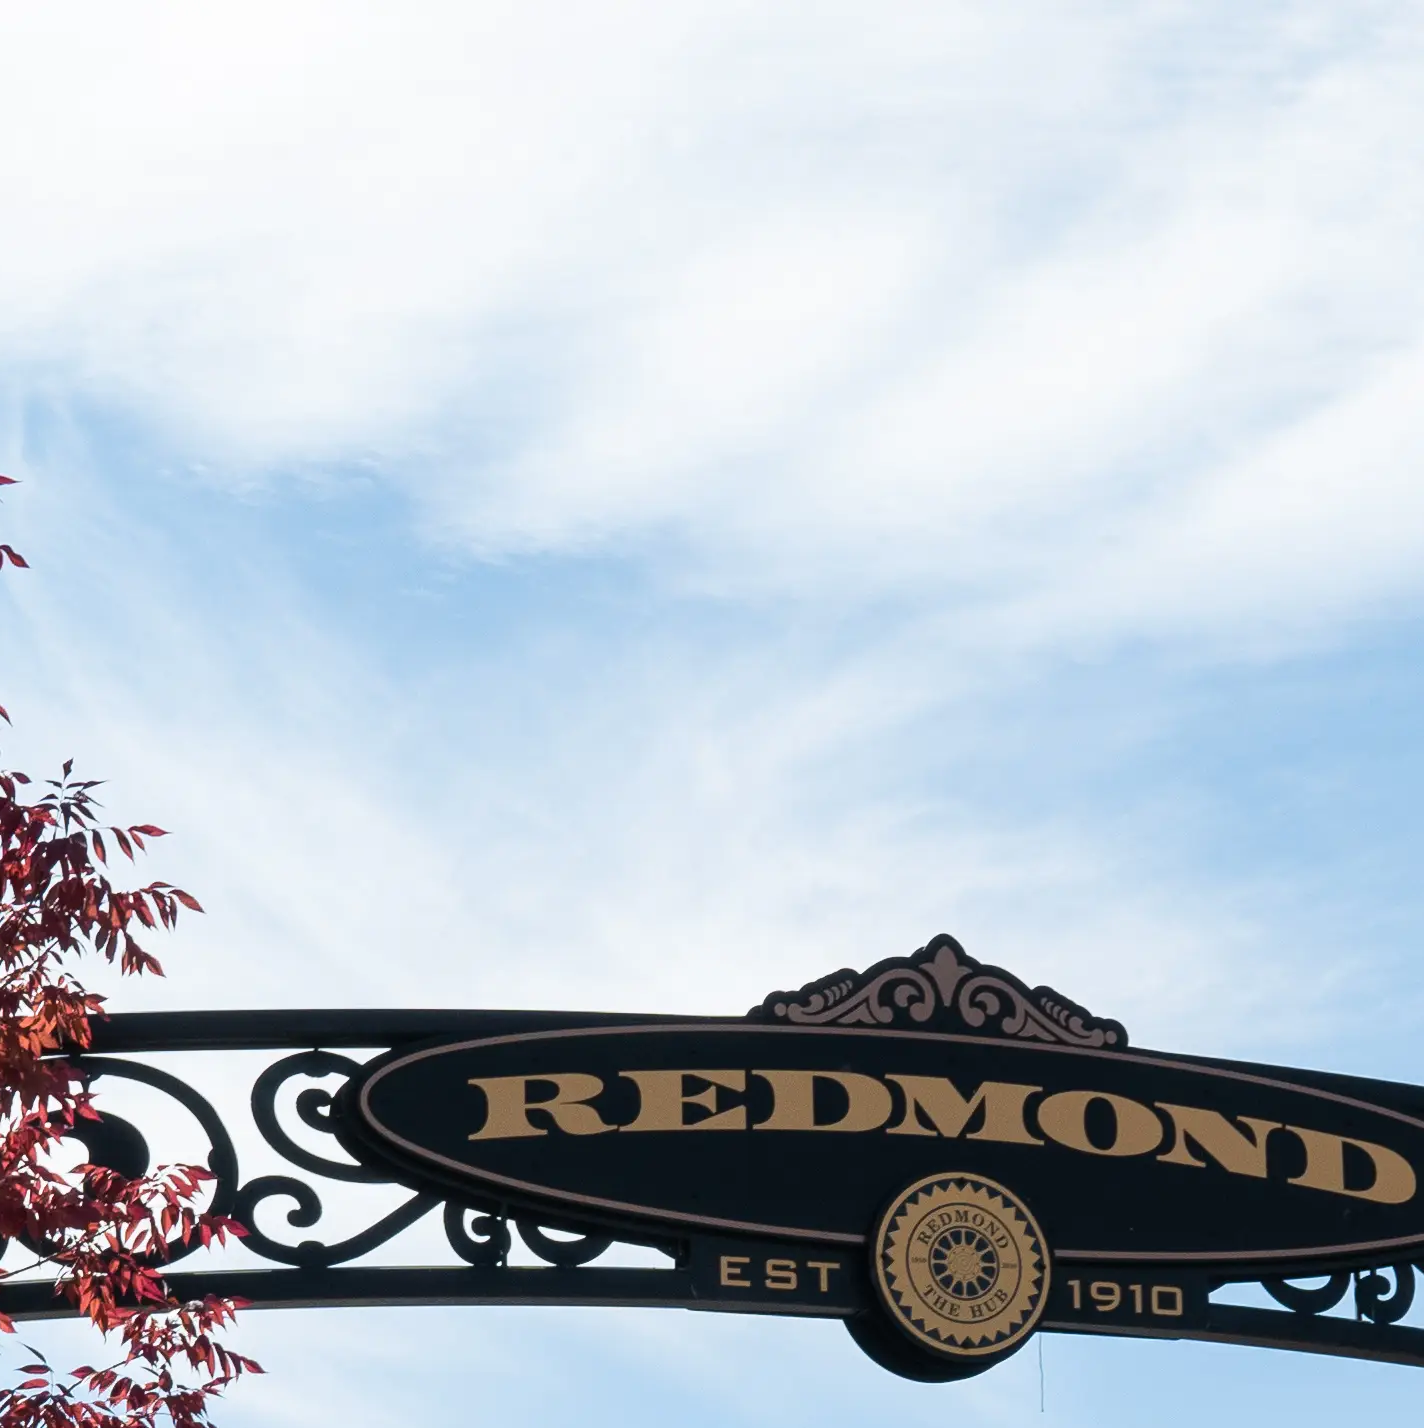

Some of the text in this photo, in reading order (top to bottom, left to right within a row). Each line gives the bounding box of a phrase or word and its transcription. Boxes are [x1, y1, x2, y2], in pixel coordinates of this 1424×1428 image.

[467, 1069, 1418, 1204] REDMOND
[917, 1210, 1010, 1249] REDMOND
[720, 1256, 841, 1292] EST
[922, 1284, 1008, 1319] THE HUB
[1067, 1279, 1183, 1316] 1910
